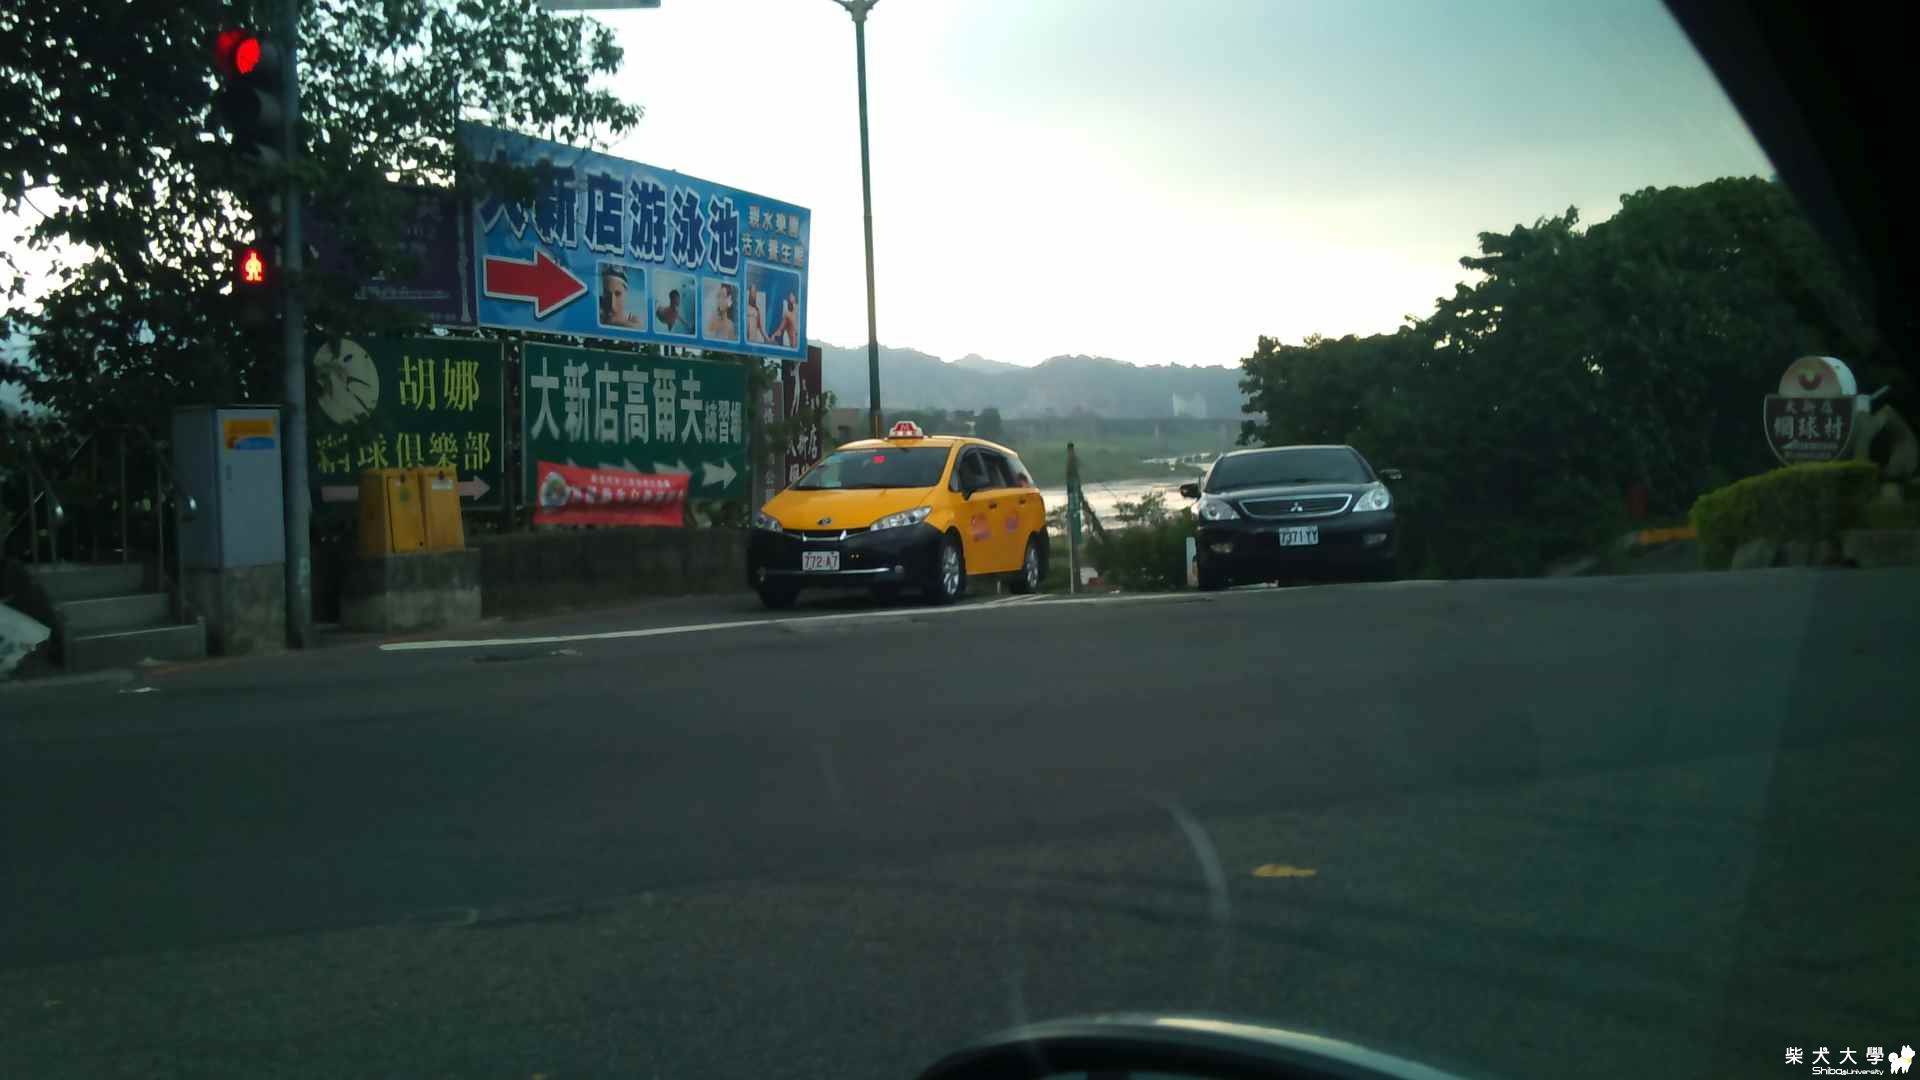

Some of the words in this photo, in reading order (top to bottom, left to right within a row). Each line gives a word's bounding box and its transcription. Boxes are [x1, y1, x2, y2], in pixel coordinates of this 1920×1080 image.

[398, 355, 480, 411] 胡娜
[315, 432, 491, 472] 網球俱樂部
